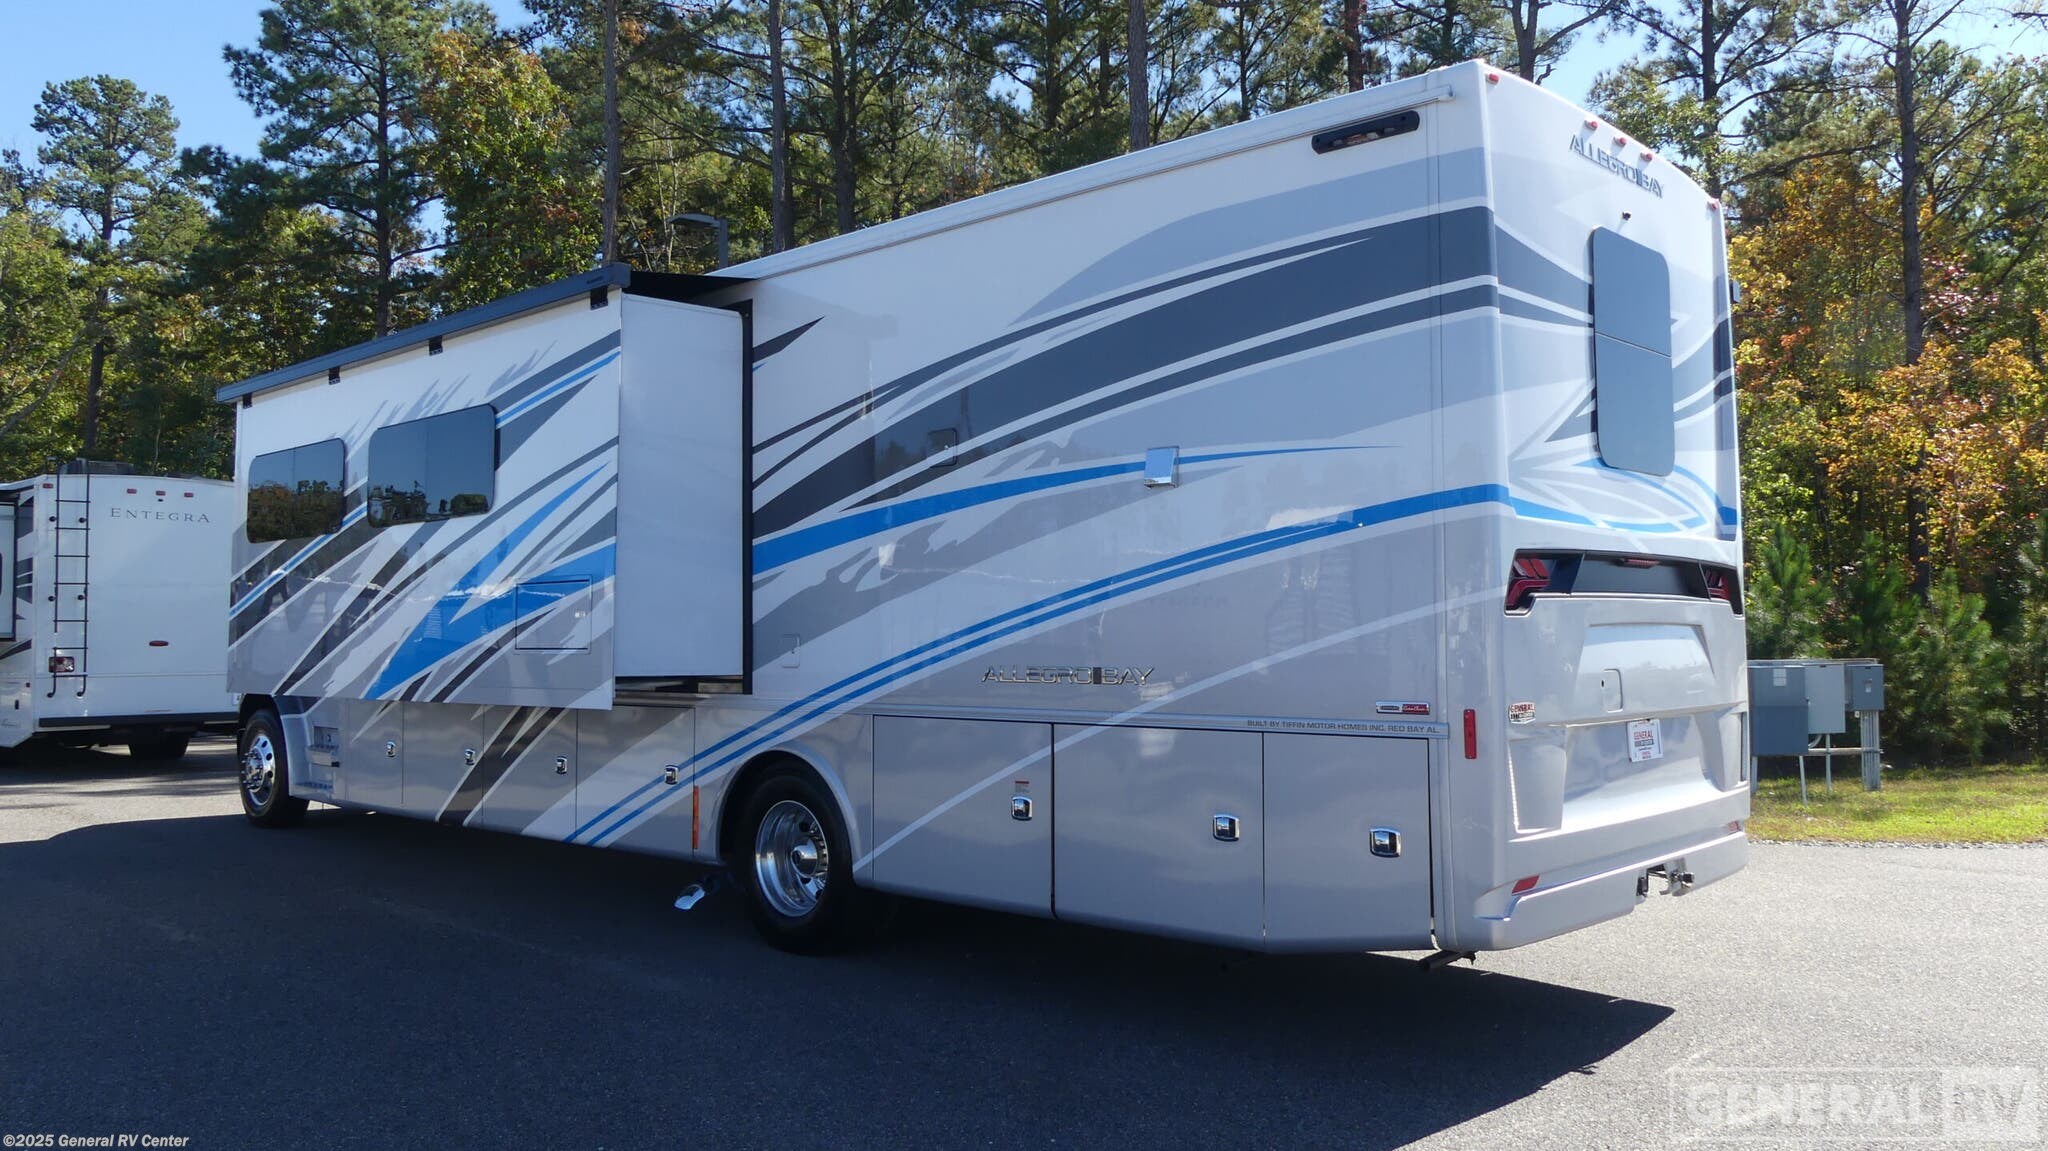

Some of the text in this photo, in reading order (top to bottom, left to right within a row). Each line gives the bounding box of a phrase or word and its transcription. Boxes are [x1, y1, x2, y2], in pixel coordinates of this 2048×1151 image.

[1569, 134, 1664, 199] ALLEGRO BAY
[111, 507, 210, 523] ENTEGRA
[982, 665, 1154, 686] ALLEGRO BAY
[1248, 719, 1267, 727] BUILT
[1269, 720, 1280, 728] BY
[1282, 720, 1306, 729] TIFFIN
[1306, 722, 1336, 730] MOTOR
[1337, 723, 1368, 731] HOMES
[1388, 725, 1405, 733] RED
[1407, 725, 1425, 733] BAY
